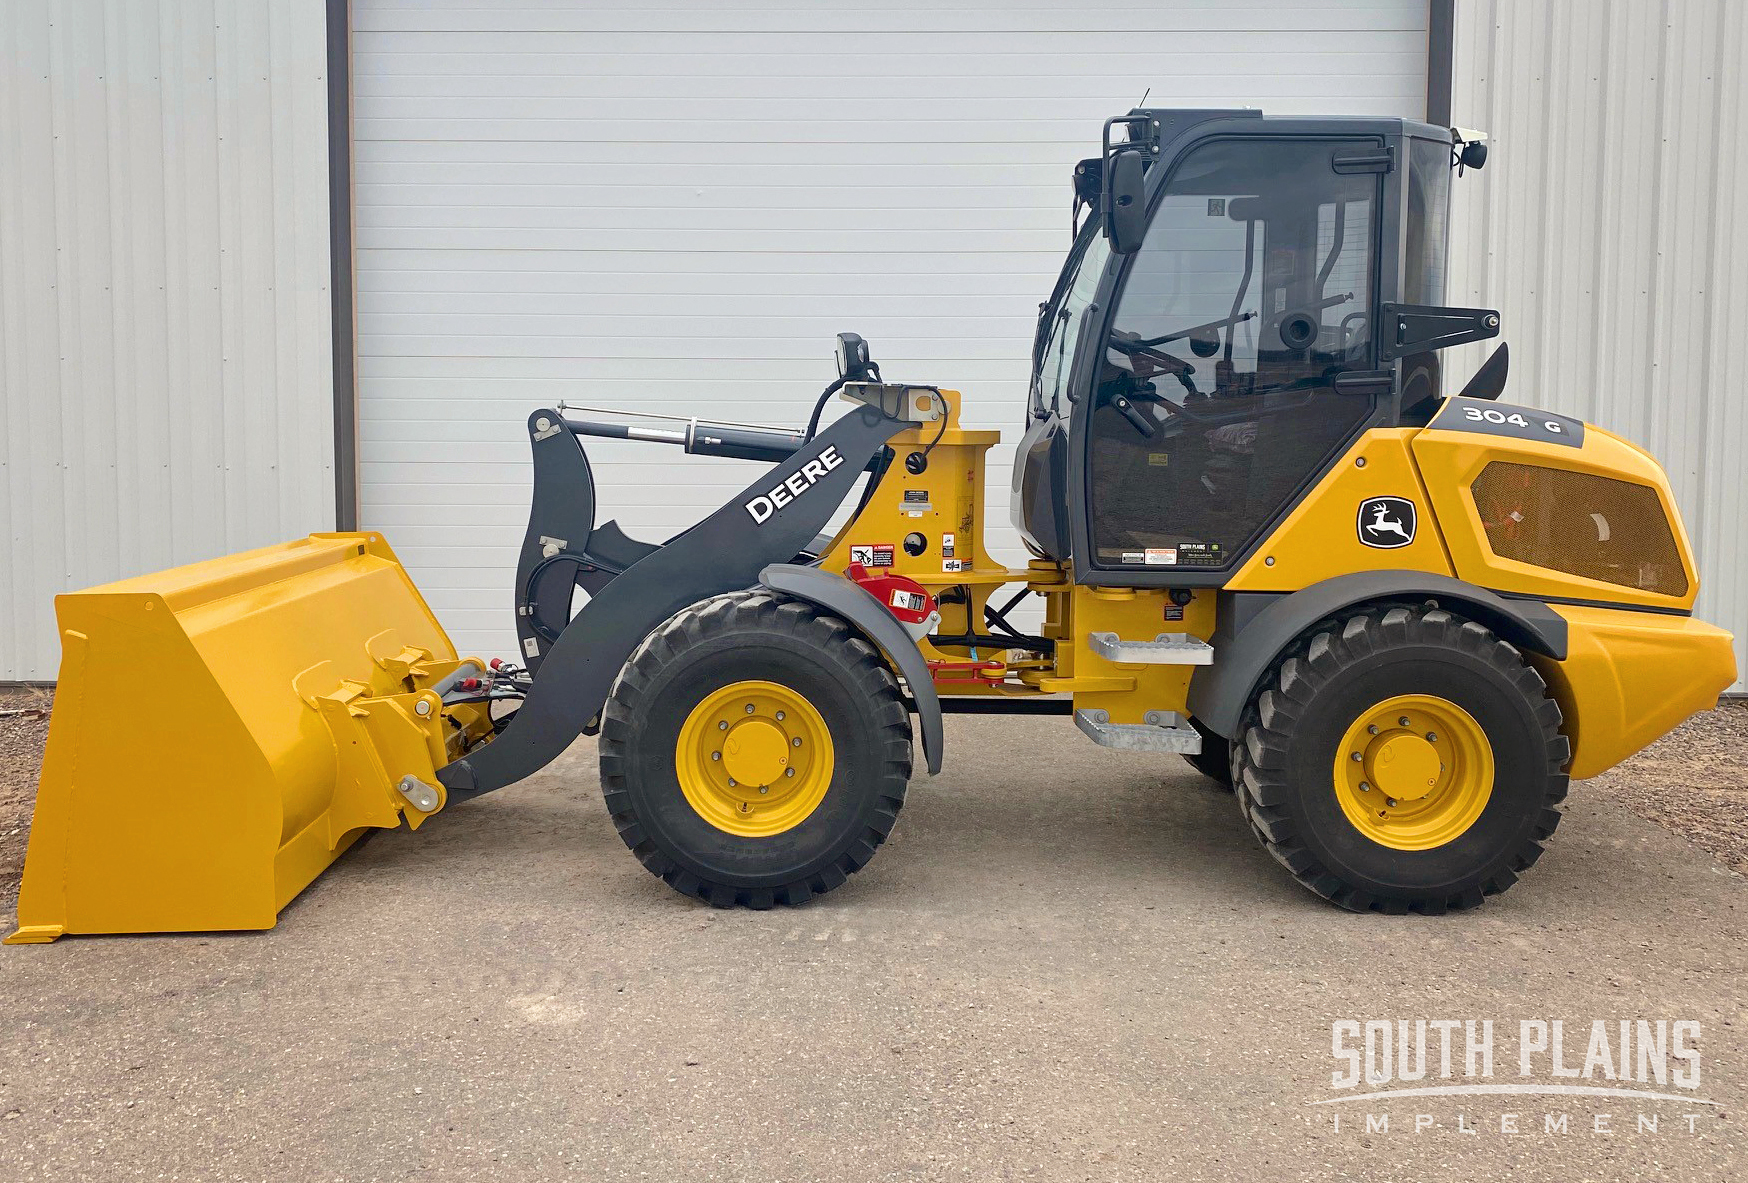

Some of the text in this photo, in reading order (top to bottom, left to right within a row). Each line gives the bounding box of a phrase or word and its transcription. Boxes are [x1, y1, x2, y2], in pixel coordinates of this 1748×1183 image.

[1462, 406, 1562, 433] 304 G
[744, 444, 845, 525] DEERE
